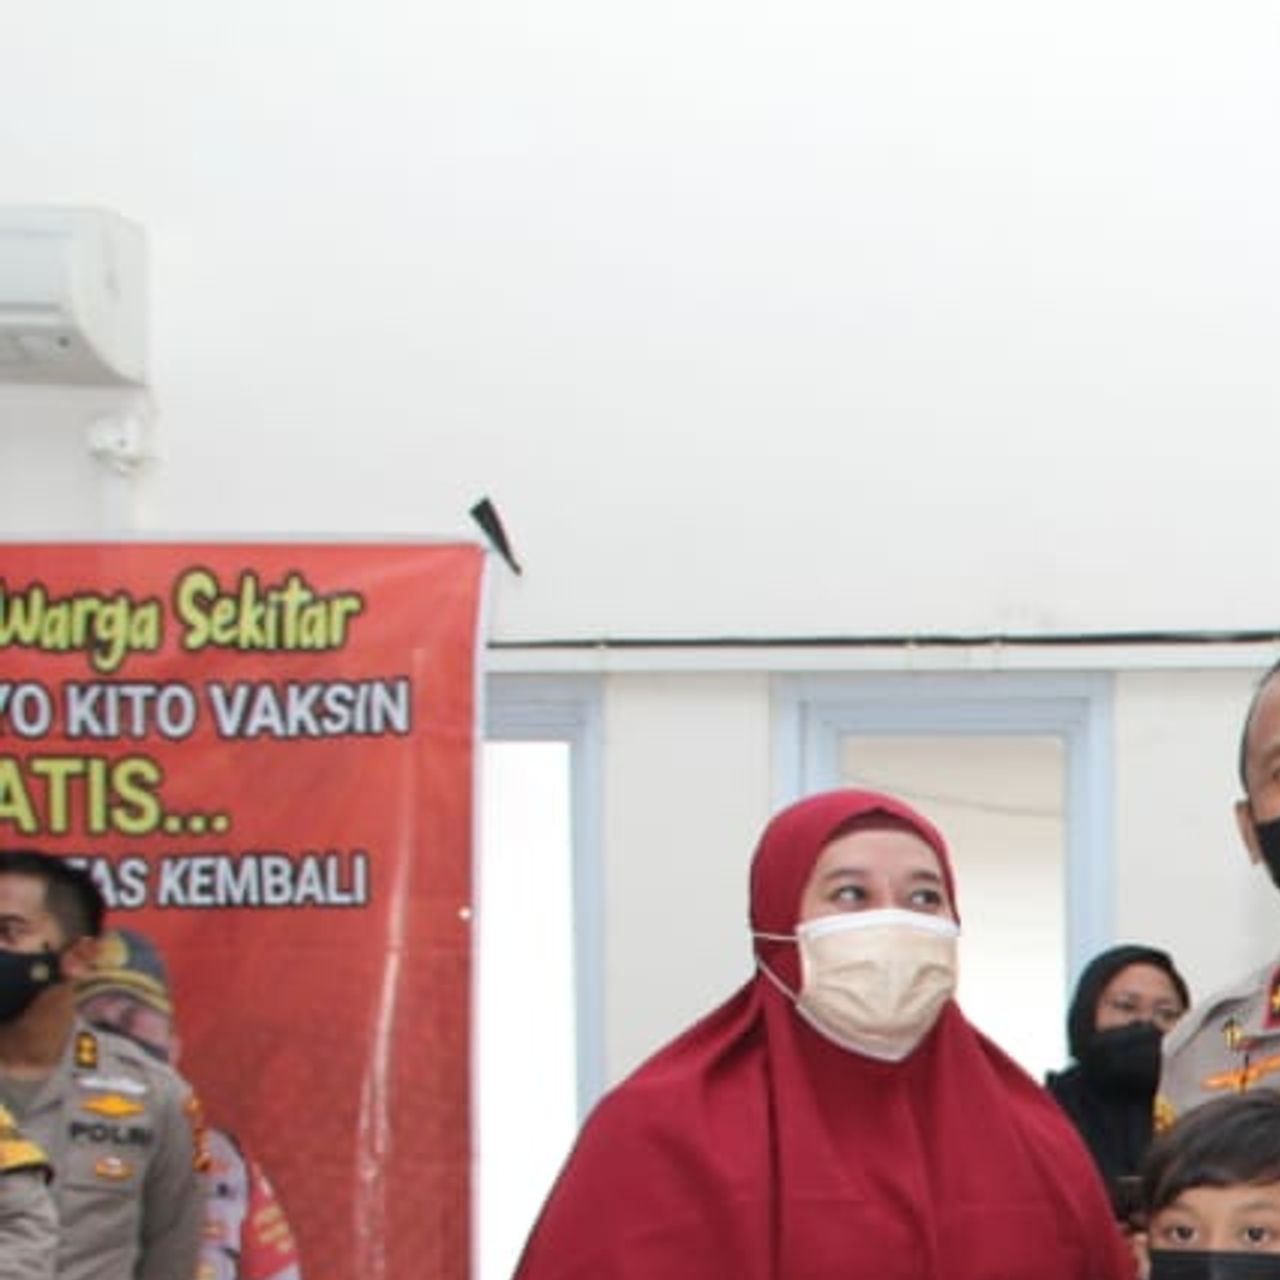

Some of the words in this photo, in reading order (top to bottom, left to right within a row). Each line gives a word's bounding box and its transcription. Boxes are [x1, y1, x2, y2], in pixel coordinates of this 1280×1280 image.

[0, 583, 162, 672] Warga
[177, 571, 363, 650] Sekitar
[0, 684, 52, 737] O
[65, 684, 196, 737] KITO
[208, 680, 411, 738] VAKSIN
[158, 855, 367, 907] KEMBALI
